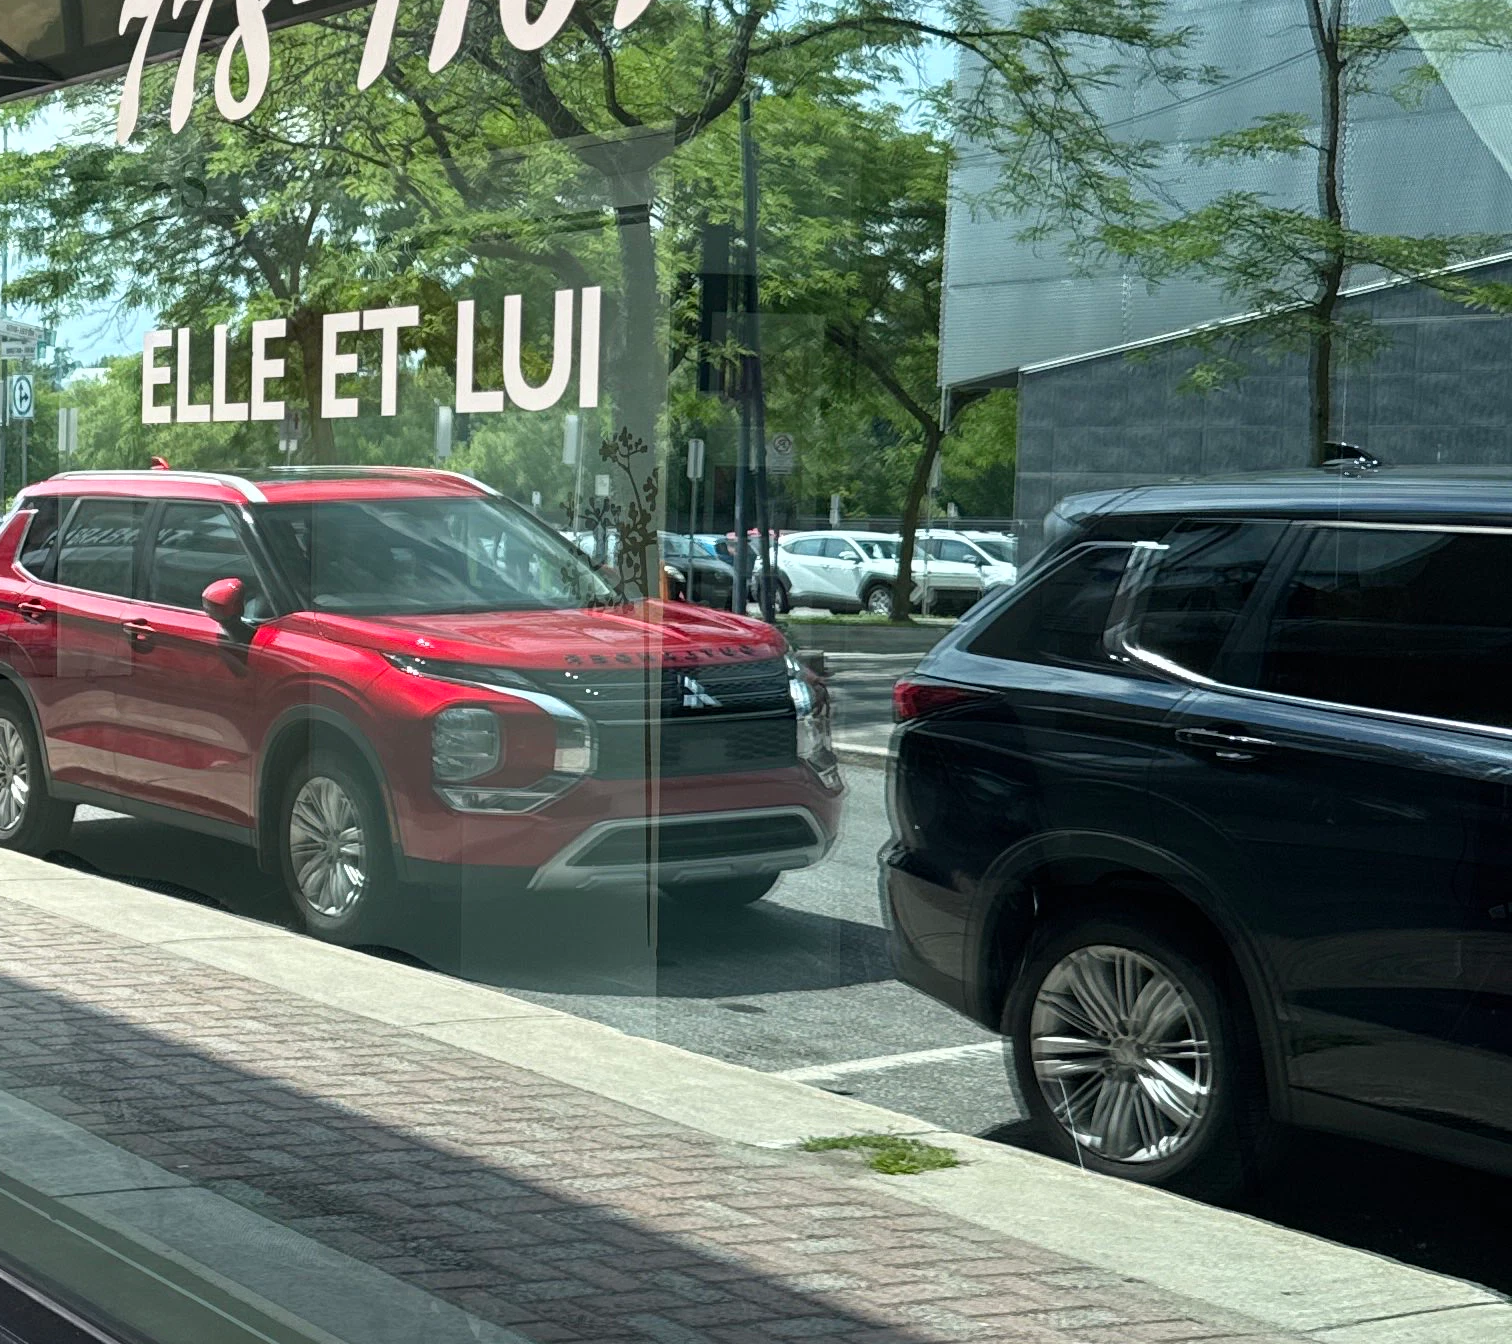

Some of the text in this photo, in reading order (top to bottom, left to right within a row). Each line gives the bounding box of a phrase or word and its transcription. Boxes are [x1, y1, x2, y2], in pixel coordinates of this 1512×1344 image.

[139, 285, 603, 425] ELLE ET LUI
